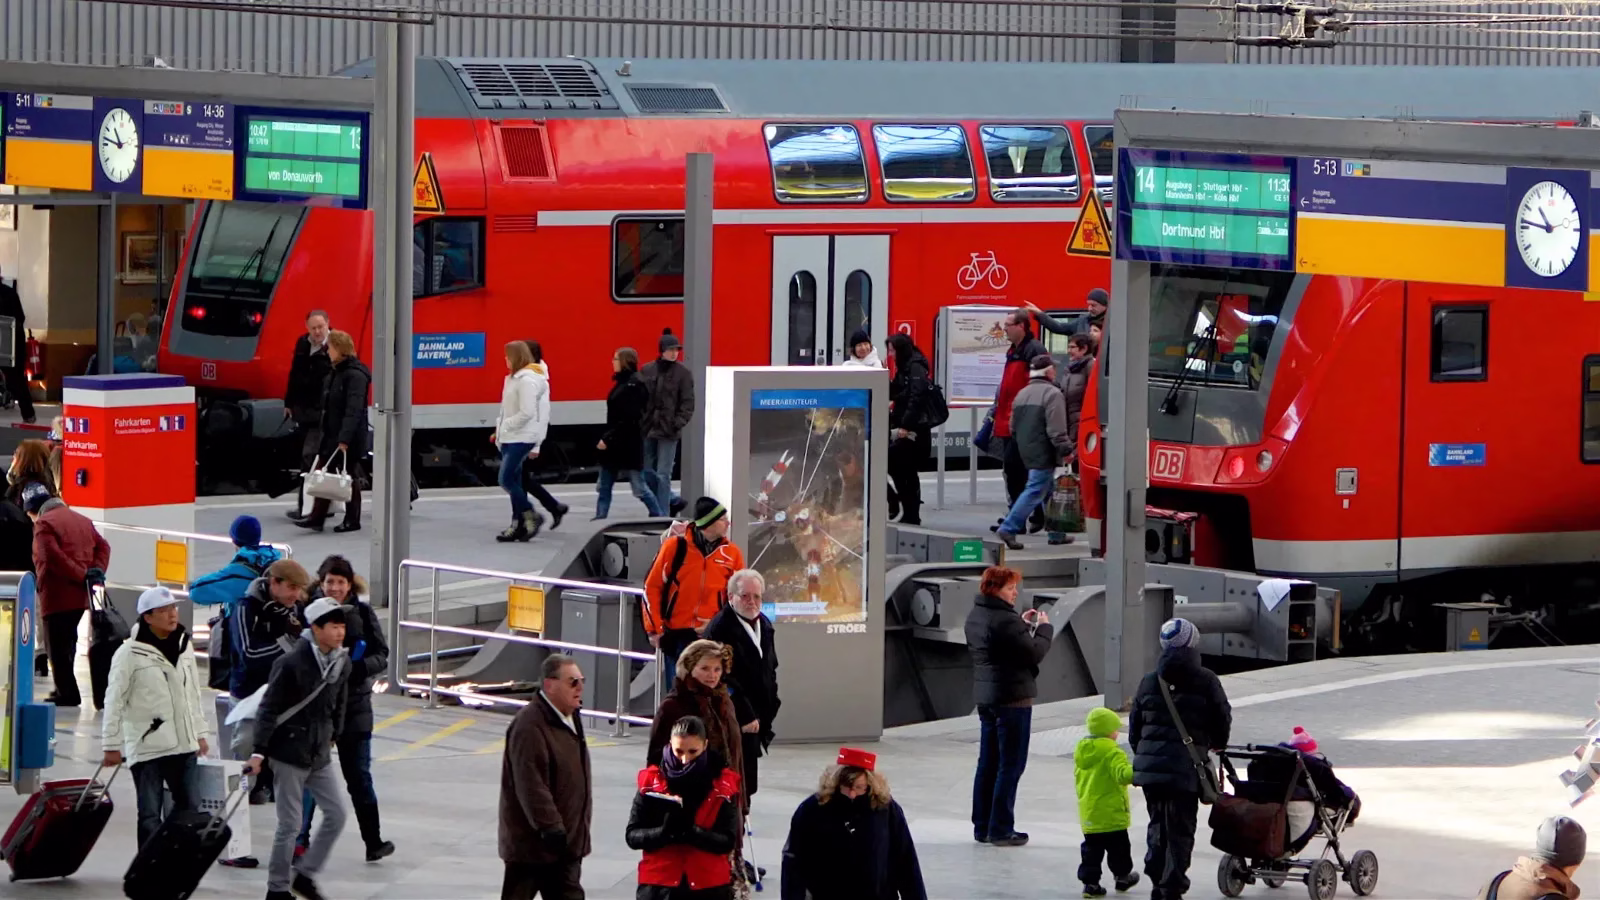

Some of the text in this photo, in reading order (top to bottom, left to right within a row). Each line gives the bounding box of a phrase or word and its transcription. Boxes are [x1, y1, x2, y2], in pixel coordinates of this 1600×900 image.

[16, 93, 31, 107] 5-11
[203, 104, 224, 118] 14-36
[249, 124, 268, 137] 10:47
[1313, 159, 1337, 176] 5-13
[267, 170, 280, 181] von
[1136, 167, 1155, 193] 14
[1165, 180, 1243, 193] Augsburg Stuttgart Hbf
[1165, 190, 1194, 200] Mannheim
[1228, 194, 1240, 202] Hbf
[1162, 222, 1226, 239] Dortmund Hbf
[418, 342, 465, 351] BAHNLAND
[417, 351, 451, 360] BAYERN
[760, 398, 818, 406] MEERABENTEUER
[114, 417, 151, 428] Fahrkarten
[64, 439, 98, 451] Fahrkarten
[1154, 450, 1182, 477] DB
[826, 623, 867, 634] STRÖER
